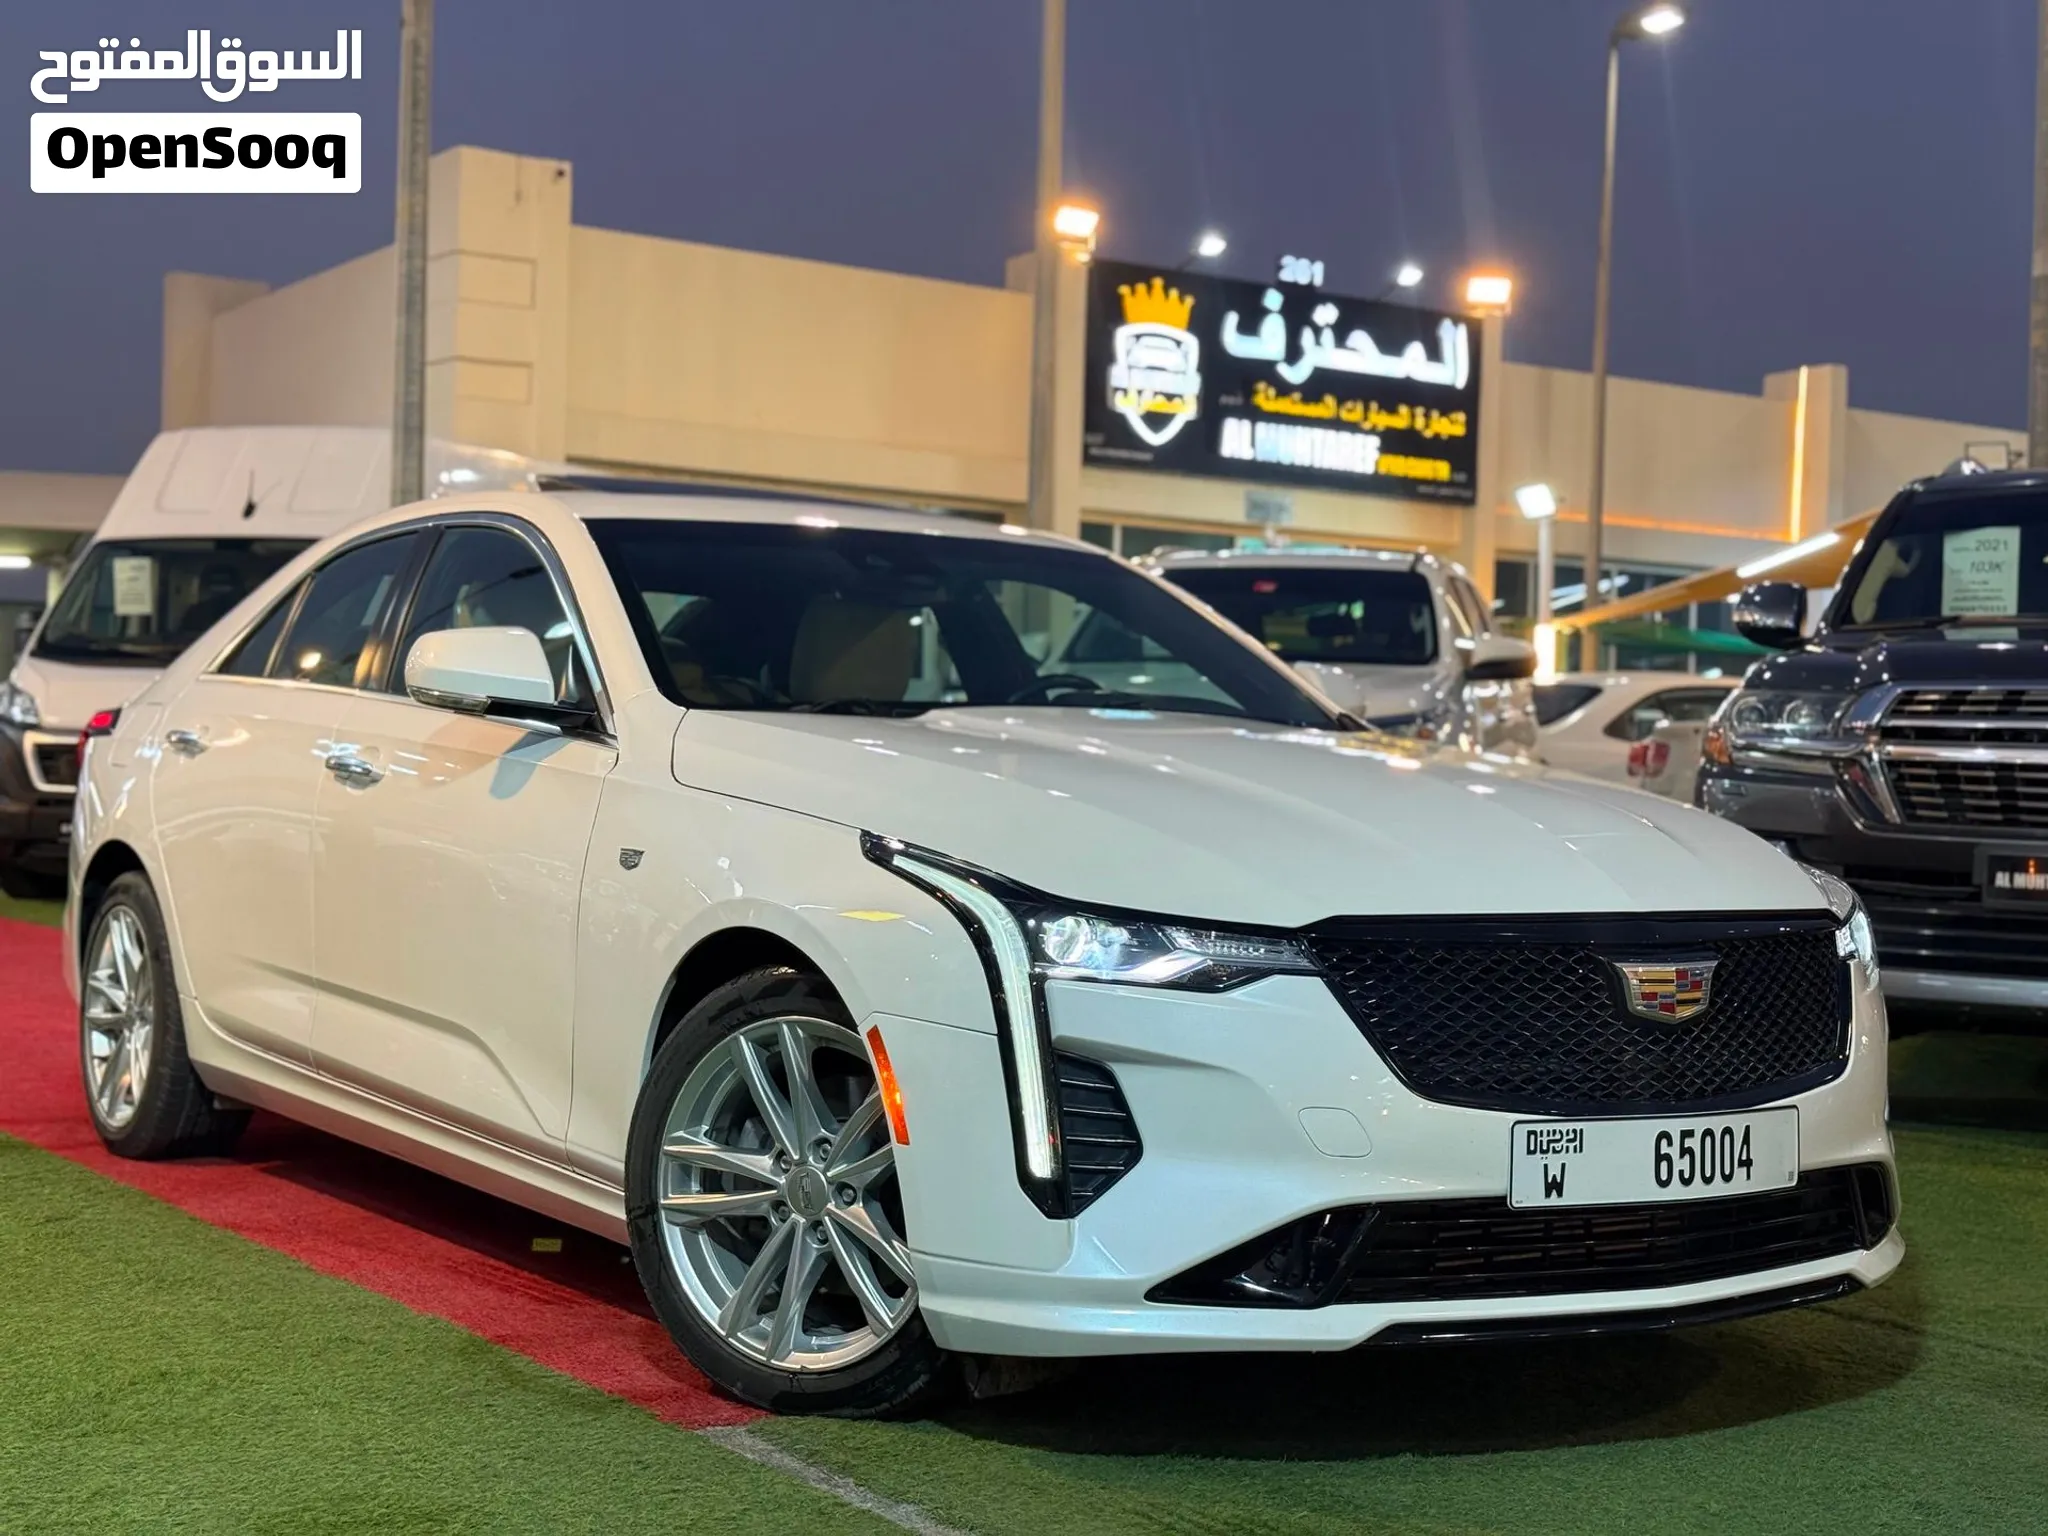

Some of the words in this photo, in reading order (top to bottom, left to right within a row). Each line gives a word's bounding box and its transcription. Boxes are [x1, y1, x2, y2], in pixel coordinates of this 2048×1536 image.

[1278, 254, 1325, 287] 201
[1219, 287, 1470, 391] المحترف
[1251, 379, 1338, 420] المستعملة
[1338, 399, 1412, 432] السيارات
[1220, 416, 1255, 460] AL
[1975, 539, 2010, 553] 2021
[1994, 870, 2012, 889] AL
[1526, 1128, 1584, 1158] DUBAI
[1654, 1123, 1754, 1189] 65004
[1543, 1162, 1566, 1199] W
